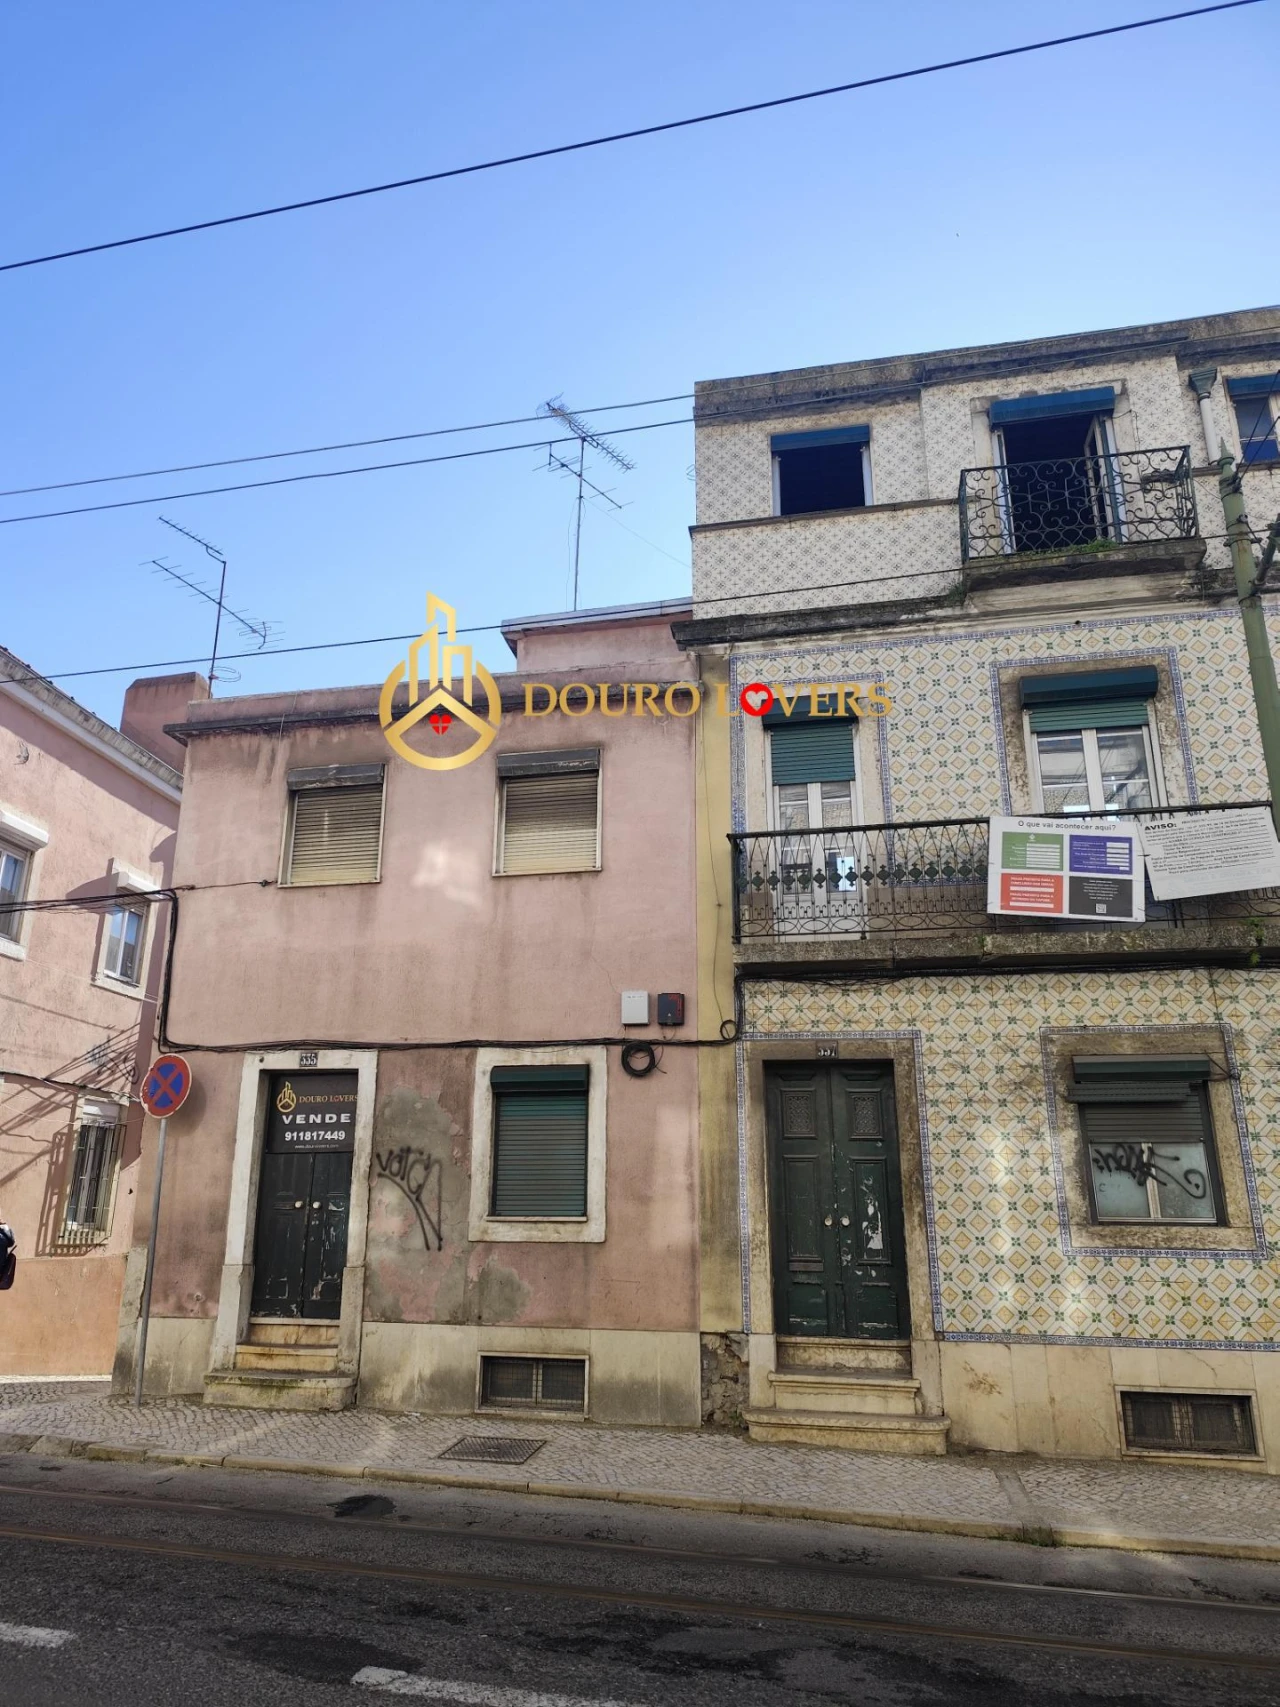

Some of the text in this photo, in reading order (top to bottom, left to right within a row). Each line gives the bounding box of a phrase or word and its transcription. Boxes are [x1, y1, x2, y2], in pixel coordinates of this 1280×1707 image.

[1055, 822, 1093, 830] acontecer
[1144, 822, 1178, 831] AVISO:
[299, 1095, 328, 1103] DOURO
[282, 1113, 351, 1124] VENDE
[285, 1130, 346, 1141] 911817449
